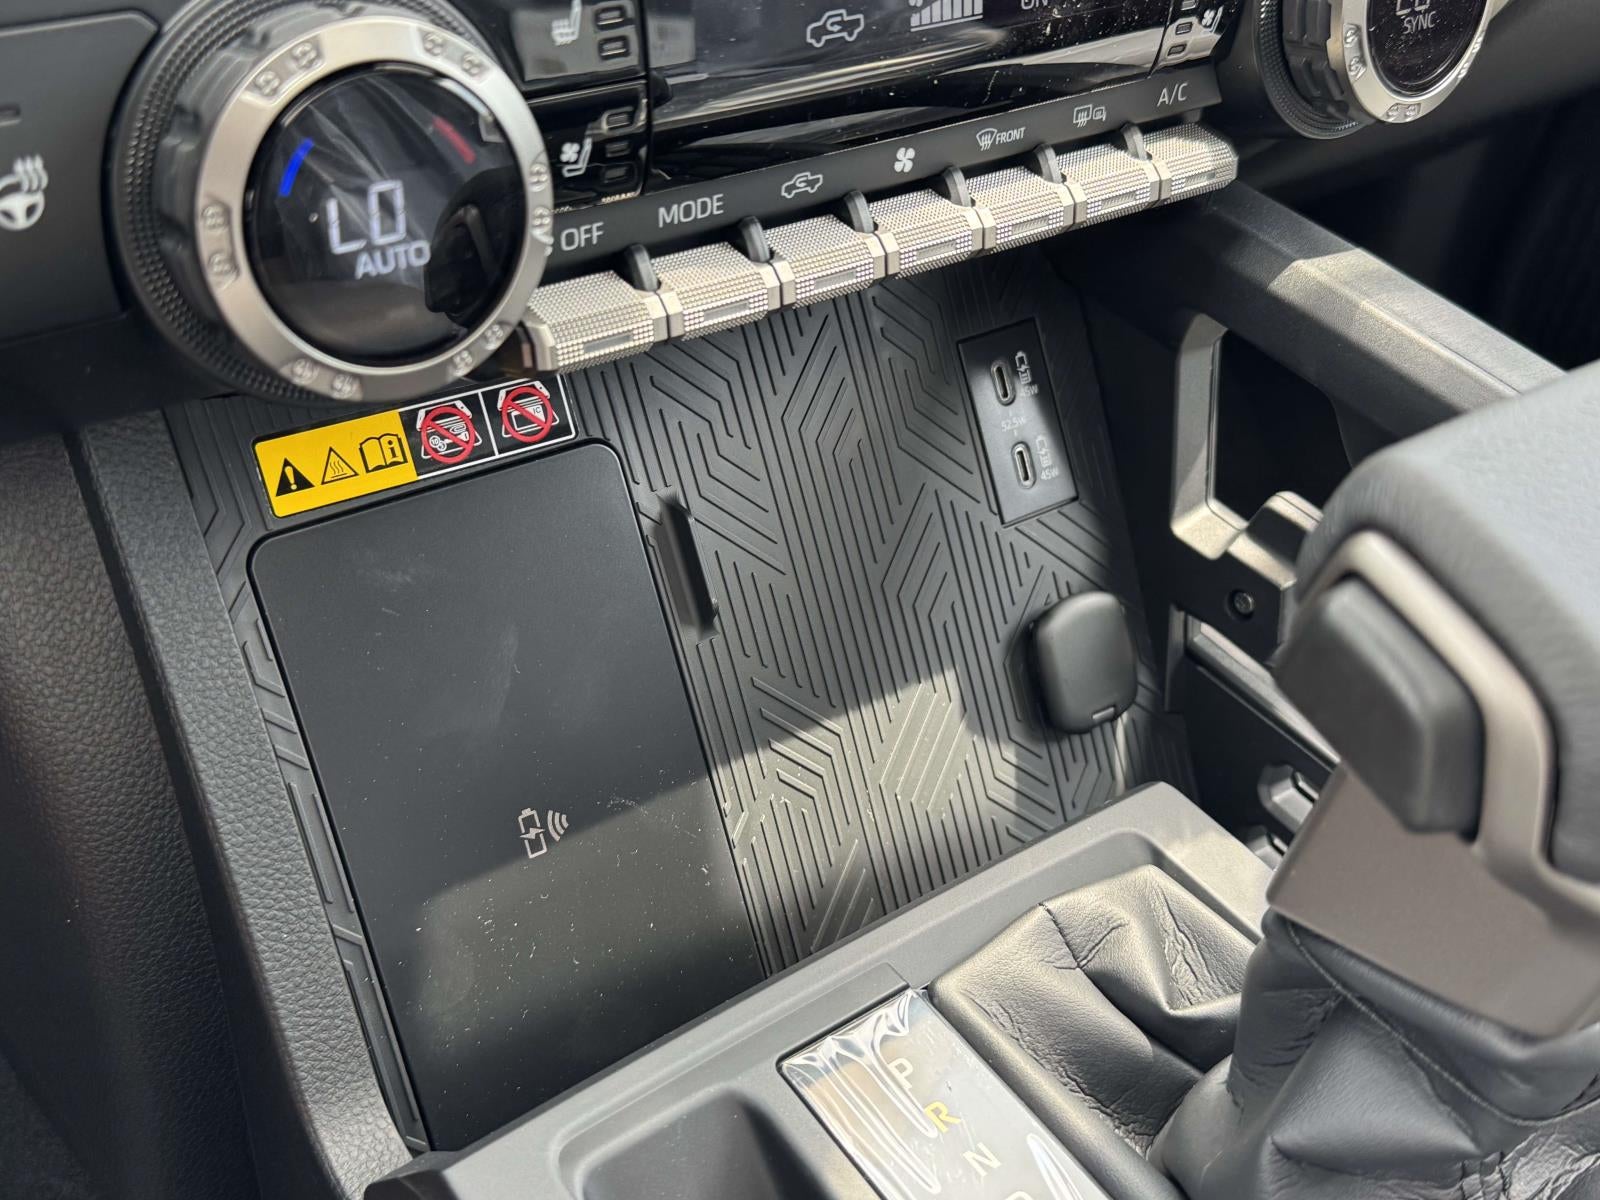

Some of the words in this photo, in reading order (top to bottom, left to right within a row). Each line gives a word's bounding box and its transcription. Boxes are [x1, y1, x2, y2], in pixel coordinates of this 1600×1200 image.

[1402, 11, 1437, 35] SYNC
[1157, 82, 1189, 107] A/C
[995, 126, 1027, 145] FRONT
[658, 193, 724, 229] MODE
[560, 221, 605, 251] OFF
[354, 239, 432, 280] AUTO
[1040, 466, 1060, 481] 45W
[888, 1057, 914, 1091] P
[924, 1101, 962, 1134] R
[962, 1141, 1002, 1178] N
